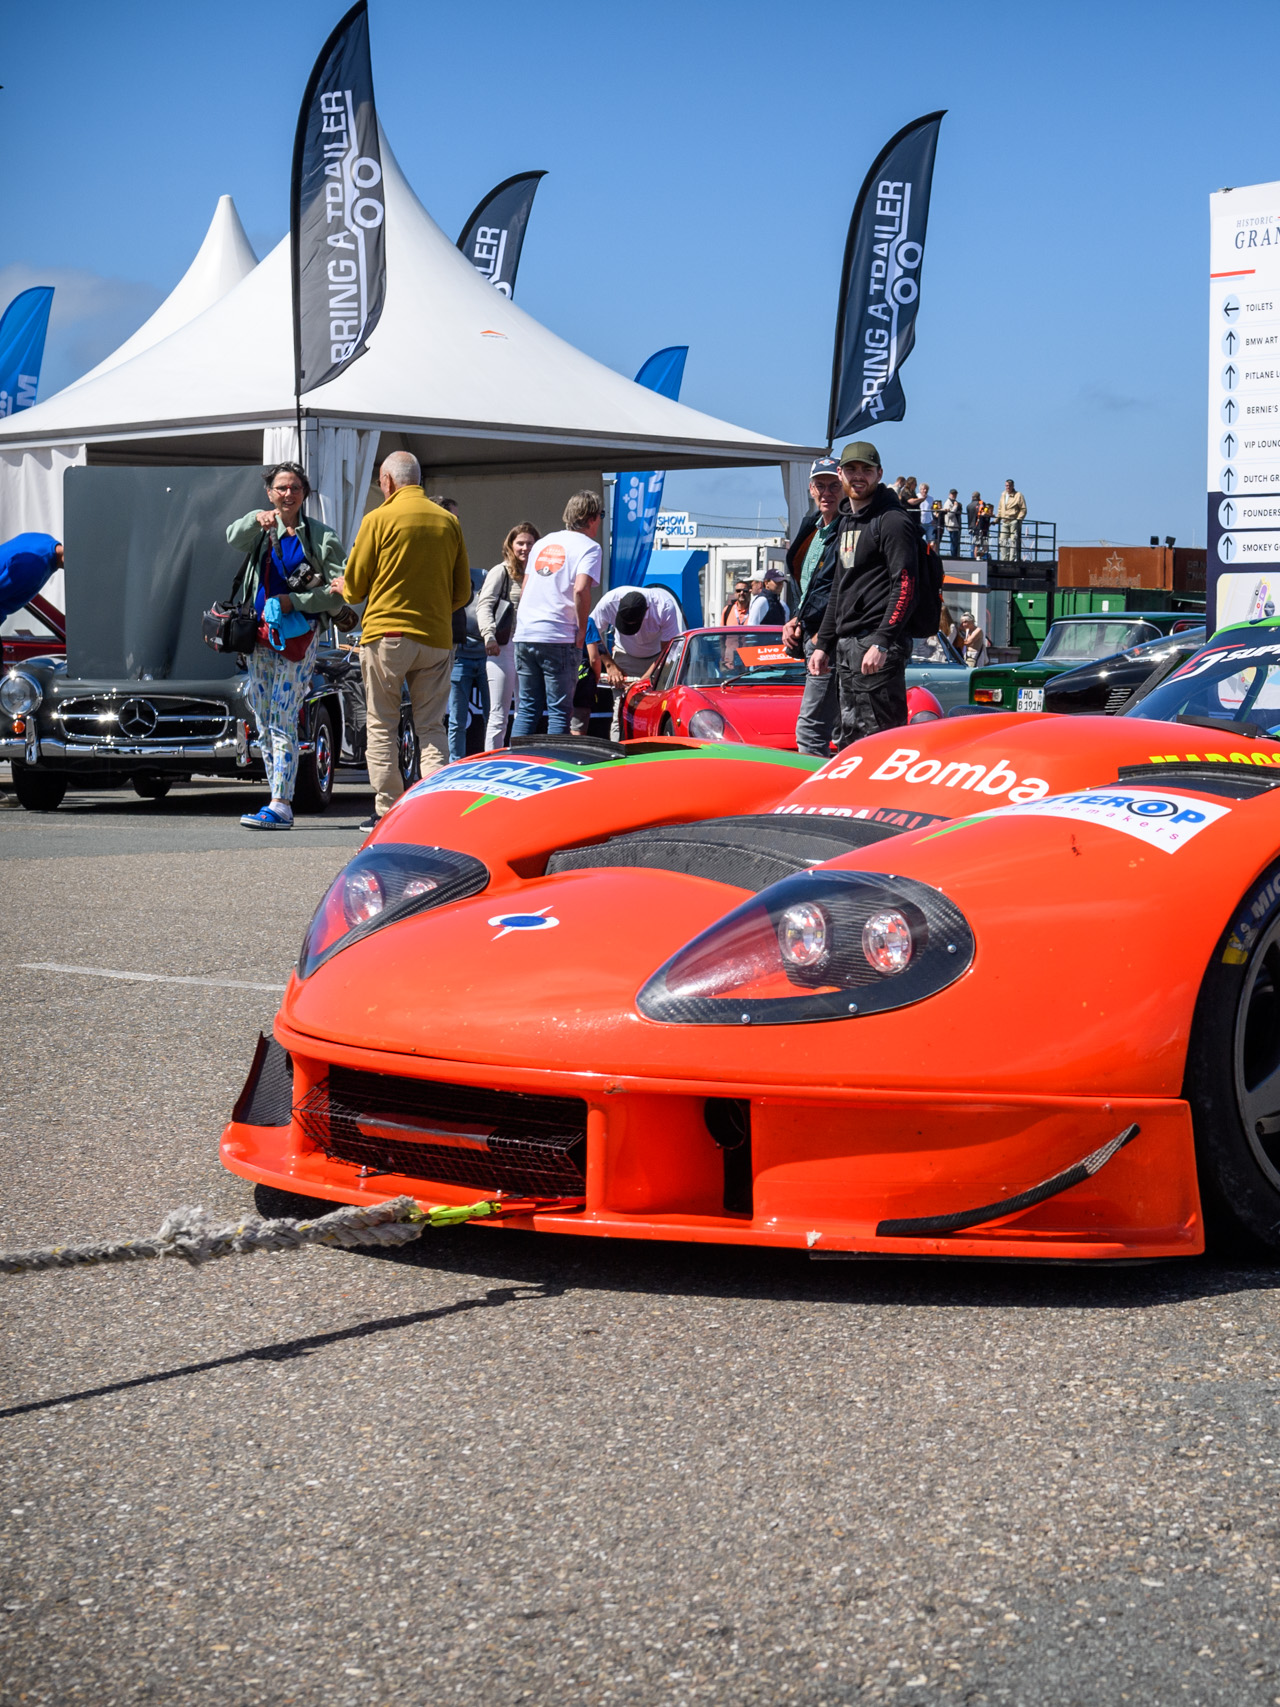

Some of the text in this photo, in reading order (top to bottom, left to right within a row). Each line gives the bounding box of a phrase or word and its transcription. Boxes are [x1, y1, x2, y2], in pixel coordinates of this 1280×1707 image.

[321, 90, 358, 364] BRING A TRAILER
[1236, 216, 1274, 228] HISTORIC
[861, 180, 903, 419] BRING A TRAILER
[1245, 301, 1273, 312] TOILETS
[1245, 337, 1264, 347] BMW
[1264, 335, 1279, 345] ART
[1245, 370, 1275, 380] PITLANE
[1244, 440, 1256, 449] VIP
[1243, 474, 1268, 485] DUTCH
[657, 516, 687, 526] SHOW
[665, 526, 694, 536] SKILLS
[1242, 543, 1273, 553] SMOKEY
[805, 748, 1050, 804] La Bomba
